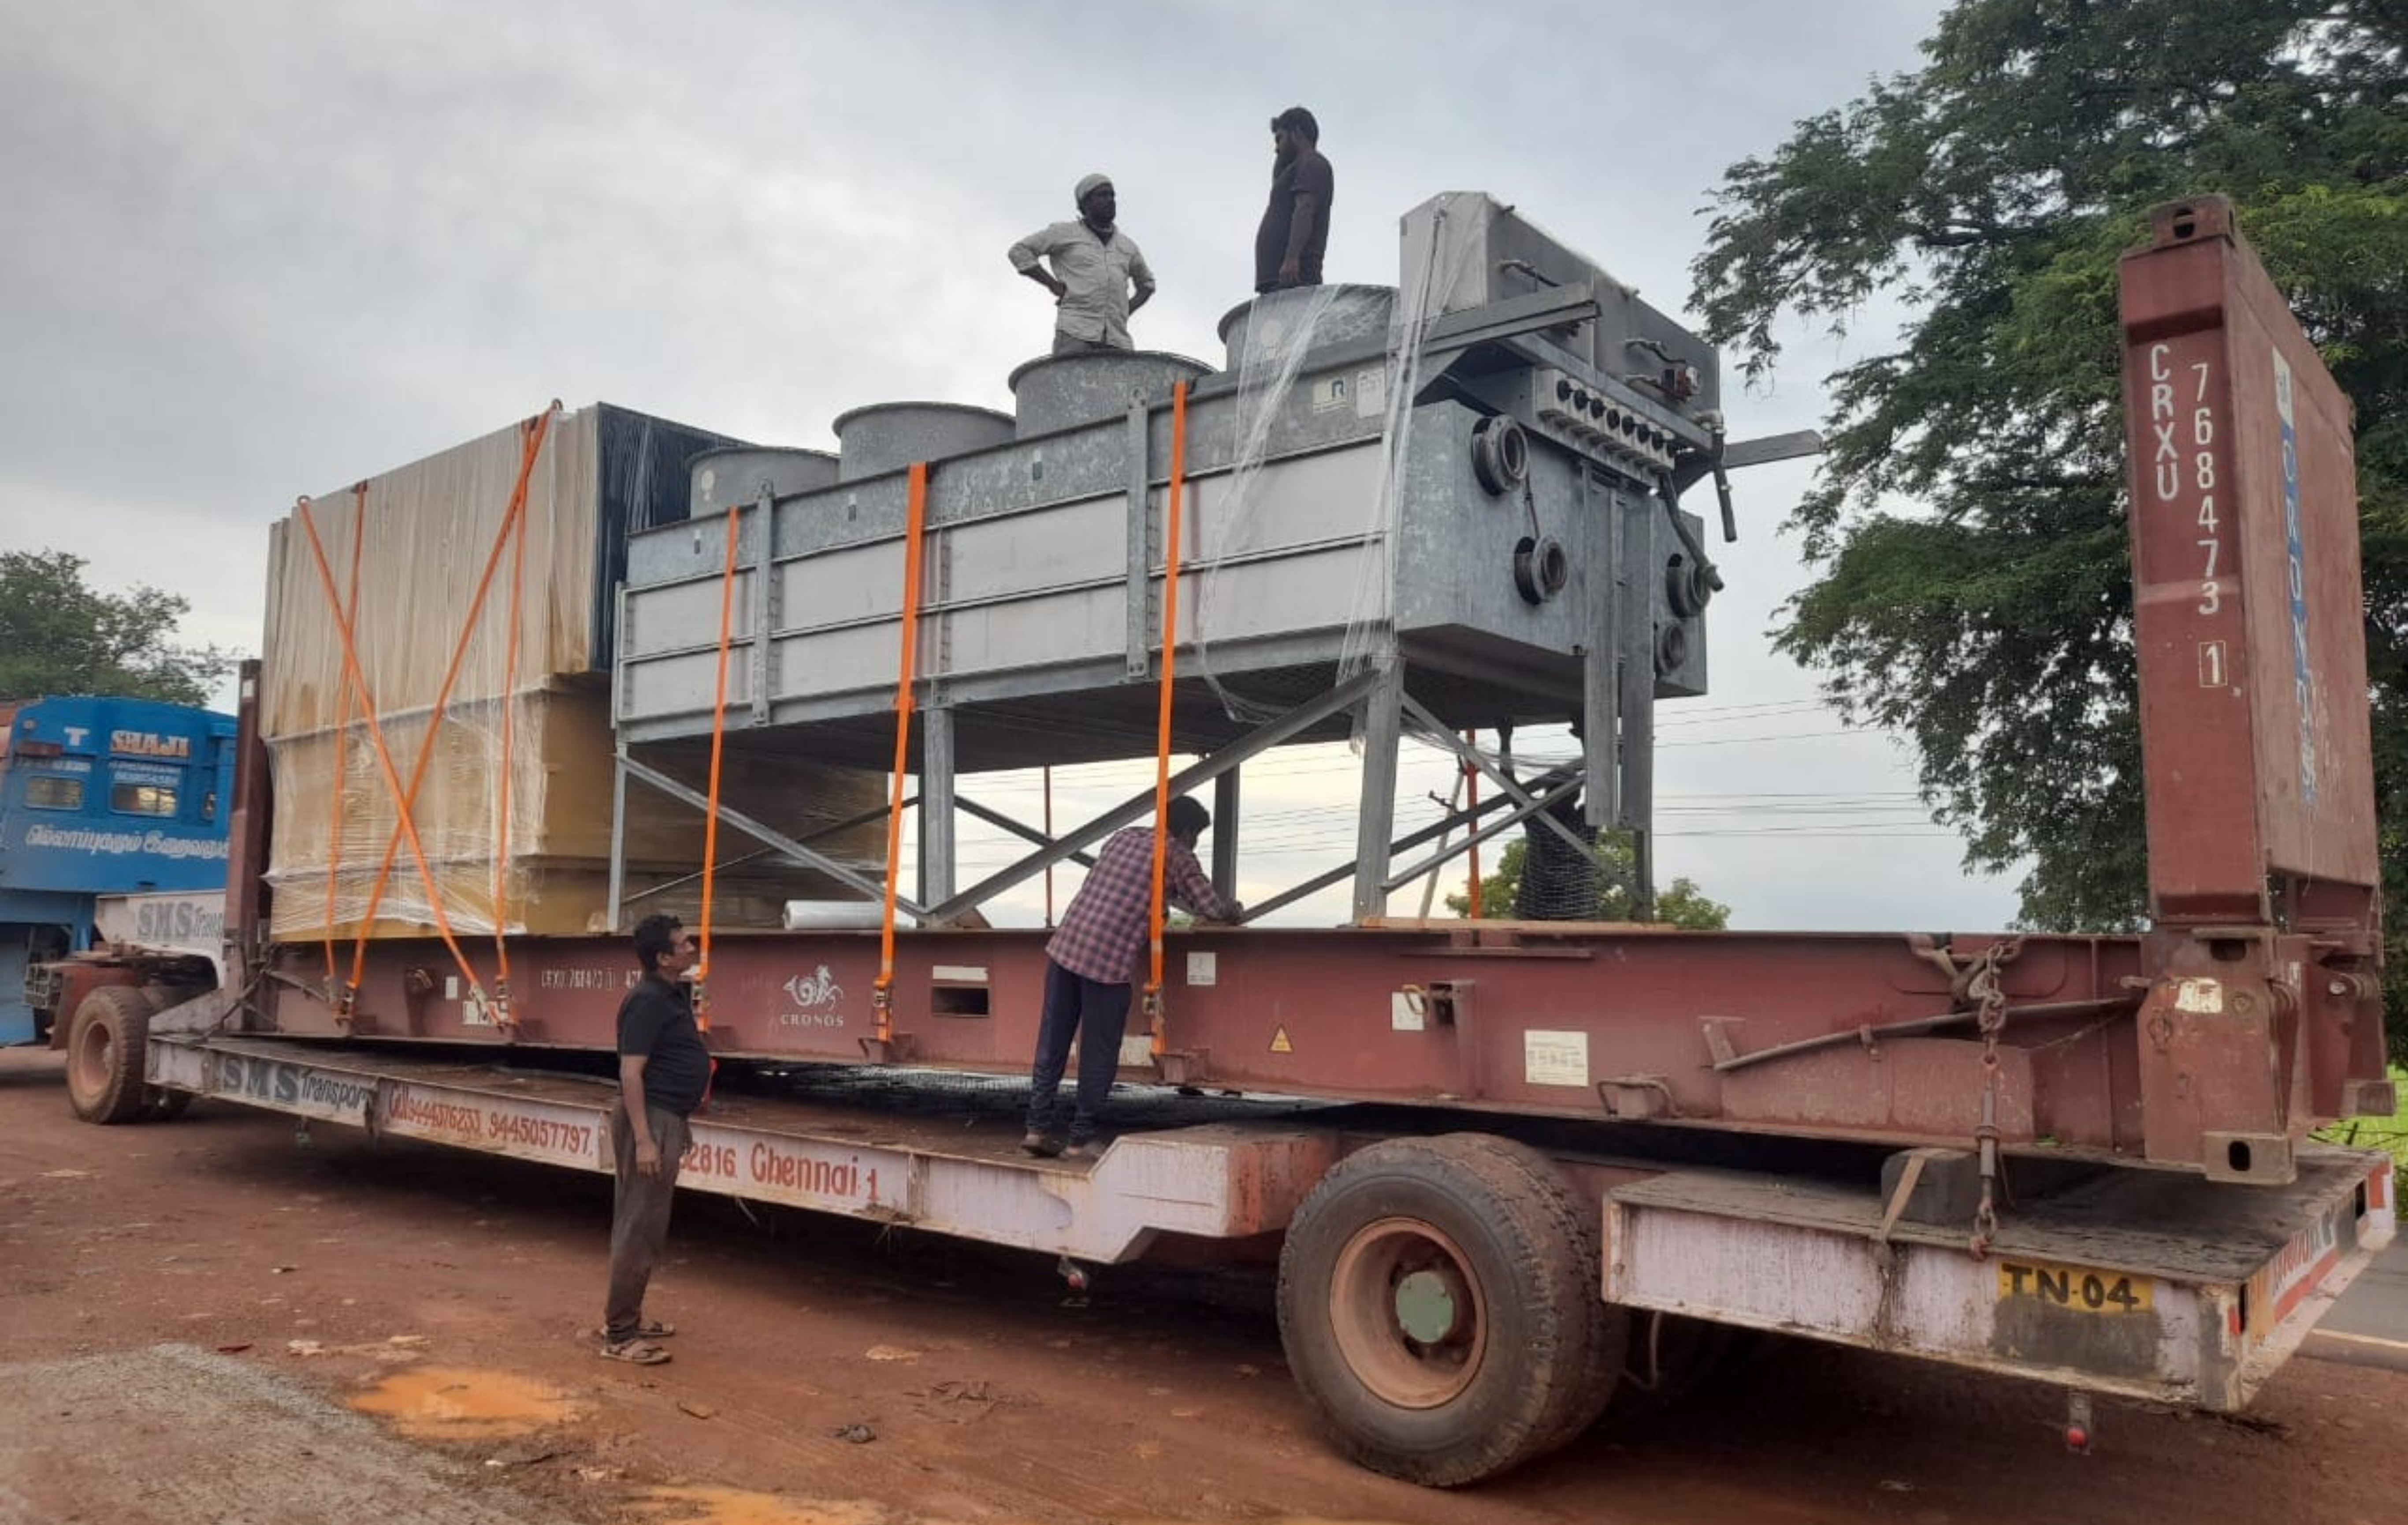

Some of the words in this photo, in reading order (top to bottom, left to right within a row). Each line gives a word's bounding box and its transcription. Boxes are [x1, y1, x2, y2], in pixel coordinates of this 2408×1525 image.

[2151, 344, 2180, 501] CRXU
[2191, 363, 2219, 615] 768473
[111, 730, 190, 757] SHAJI
[137, 902, 194, 941] SMS
[780, 1014, 844, 1027] CRONOS
[223, 1057, 298, 1104] SMS
